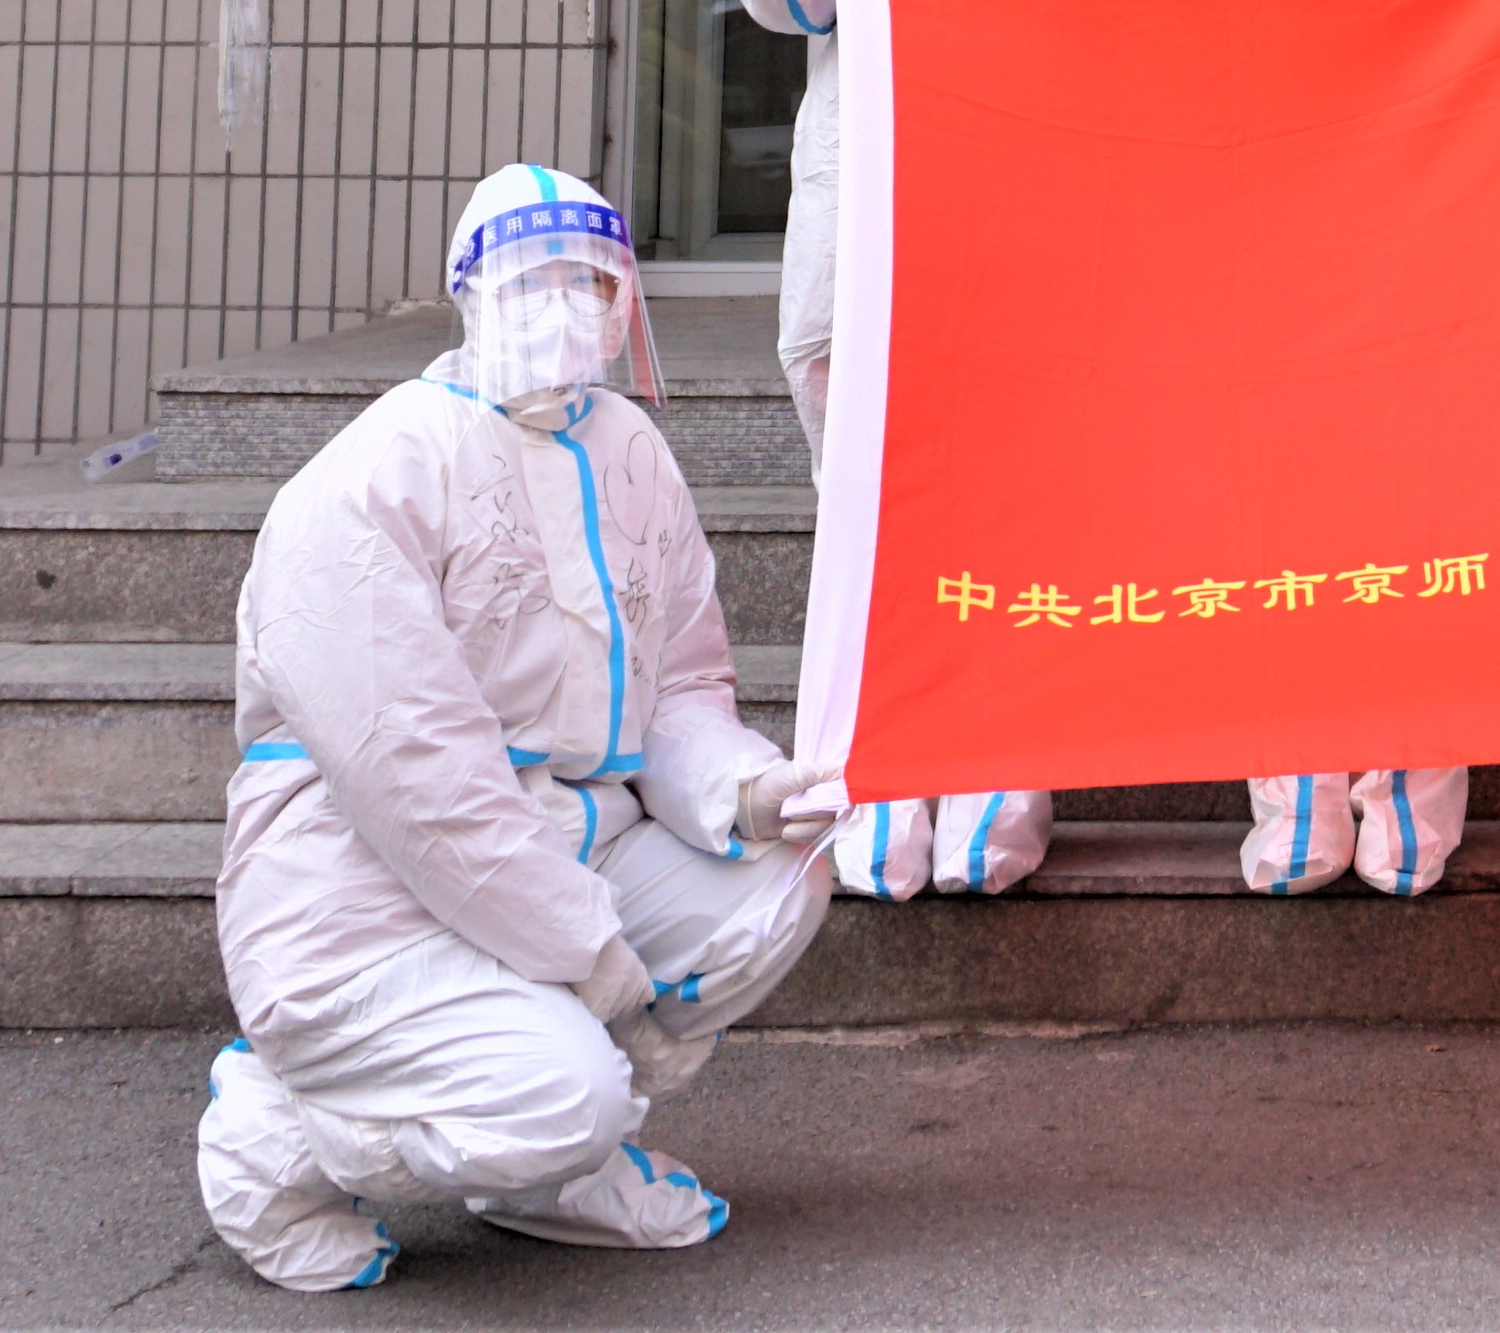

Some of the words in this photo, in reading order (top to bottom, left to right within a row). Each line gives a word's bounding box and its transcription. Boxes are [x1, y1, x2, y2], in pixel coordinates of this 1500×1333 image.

[483, 208, 623, 246] 医用隔离面罩
